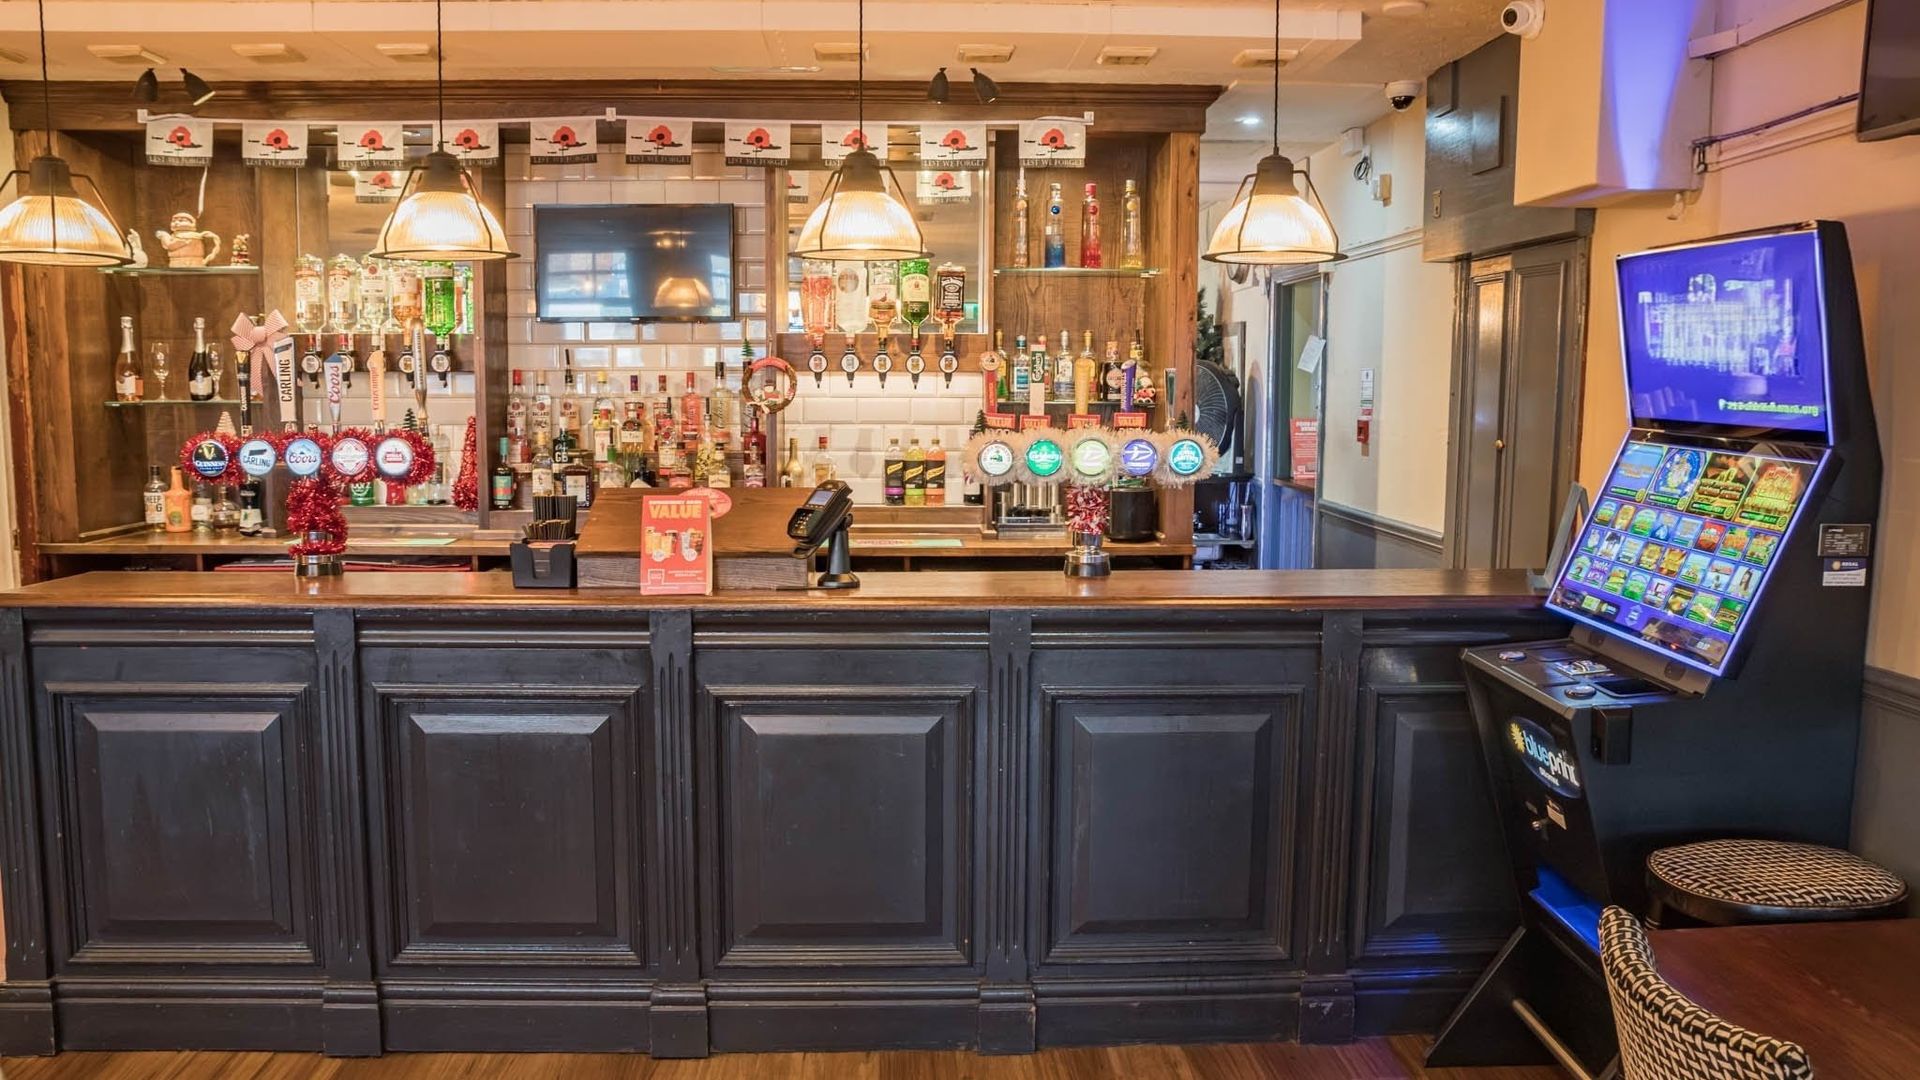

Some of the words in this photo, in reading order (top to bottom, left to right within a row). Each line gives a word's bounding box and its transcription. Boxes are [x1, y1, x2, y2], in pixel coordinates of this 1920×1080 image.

[956, 160, 984, 168] FORGET
[1054, 159, 1083, 167] FORGET
[1033, 353, 1044, 381] Carlsberg
[279, 359, 293, 402] CARLING
[329, 365, 343, 405] Coors
[243, 455, 271, 467] CARLING
[289, 454, 317, 464] Coors
[648, 504, 703, 519] VALUE
[1522, 729, 1580, 788] blueprint
